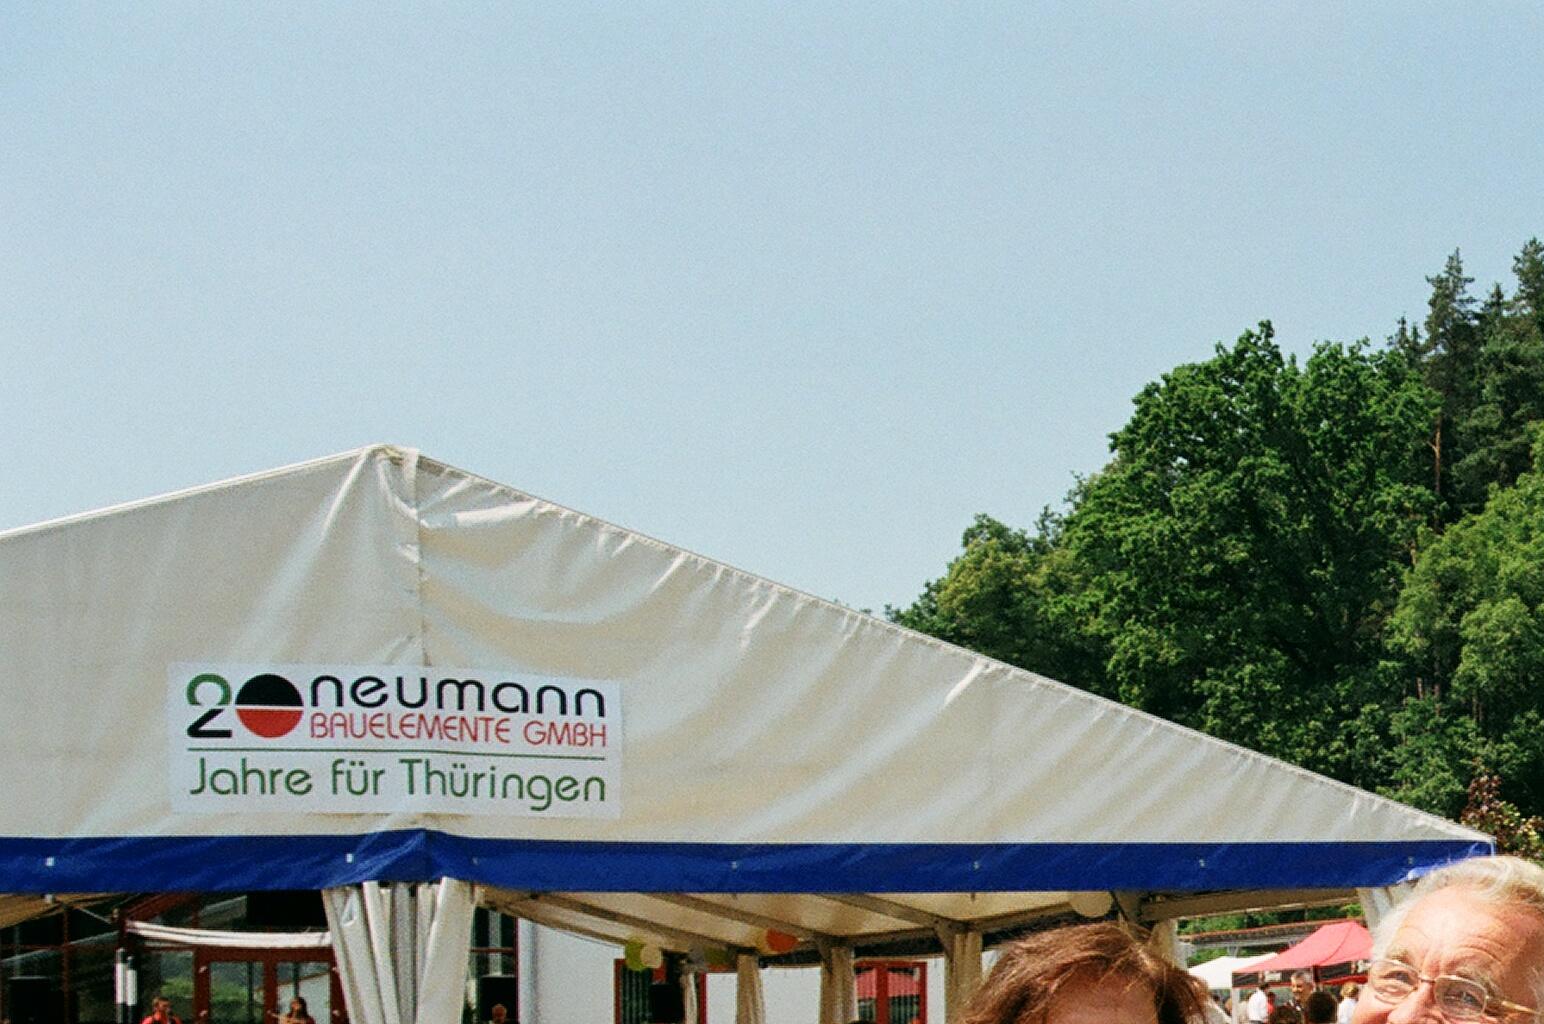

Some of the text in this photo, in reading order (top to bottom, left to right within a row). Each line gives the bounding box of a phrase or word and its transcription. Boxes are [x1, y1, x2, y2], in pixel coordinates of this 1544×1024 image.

[310, 674, 606, 717] neumann
[310, 712, 607, 747] BAUELEMENTE GMBH
[190, 757, 606, 812] Jahre für Thüringen
